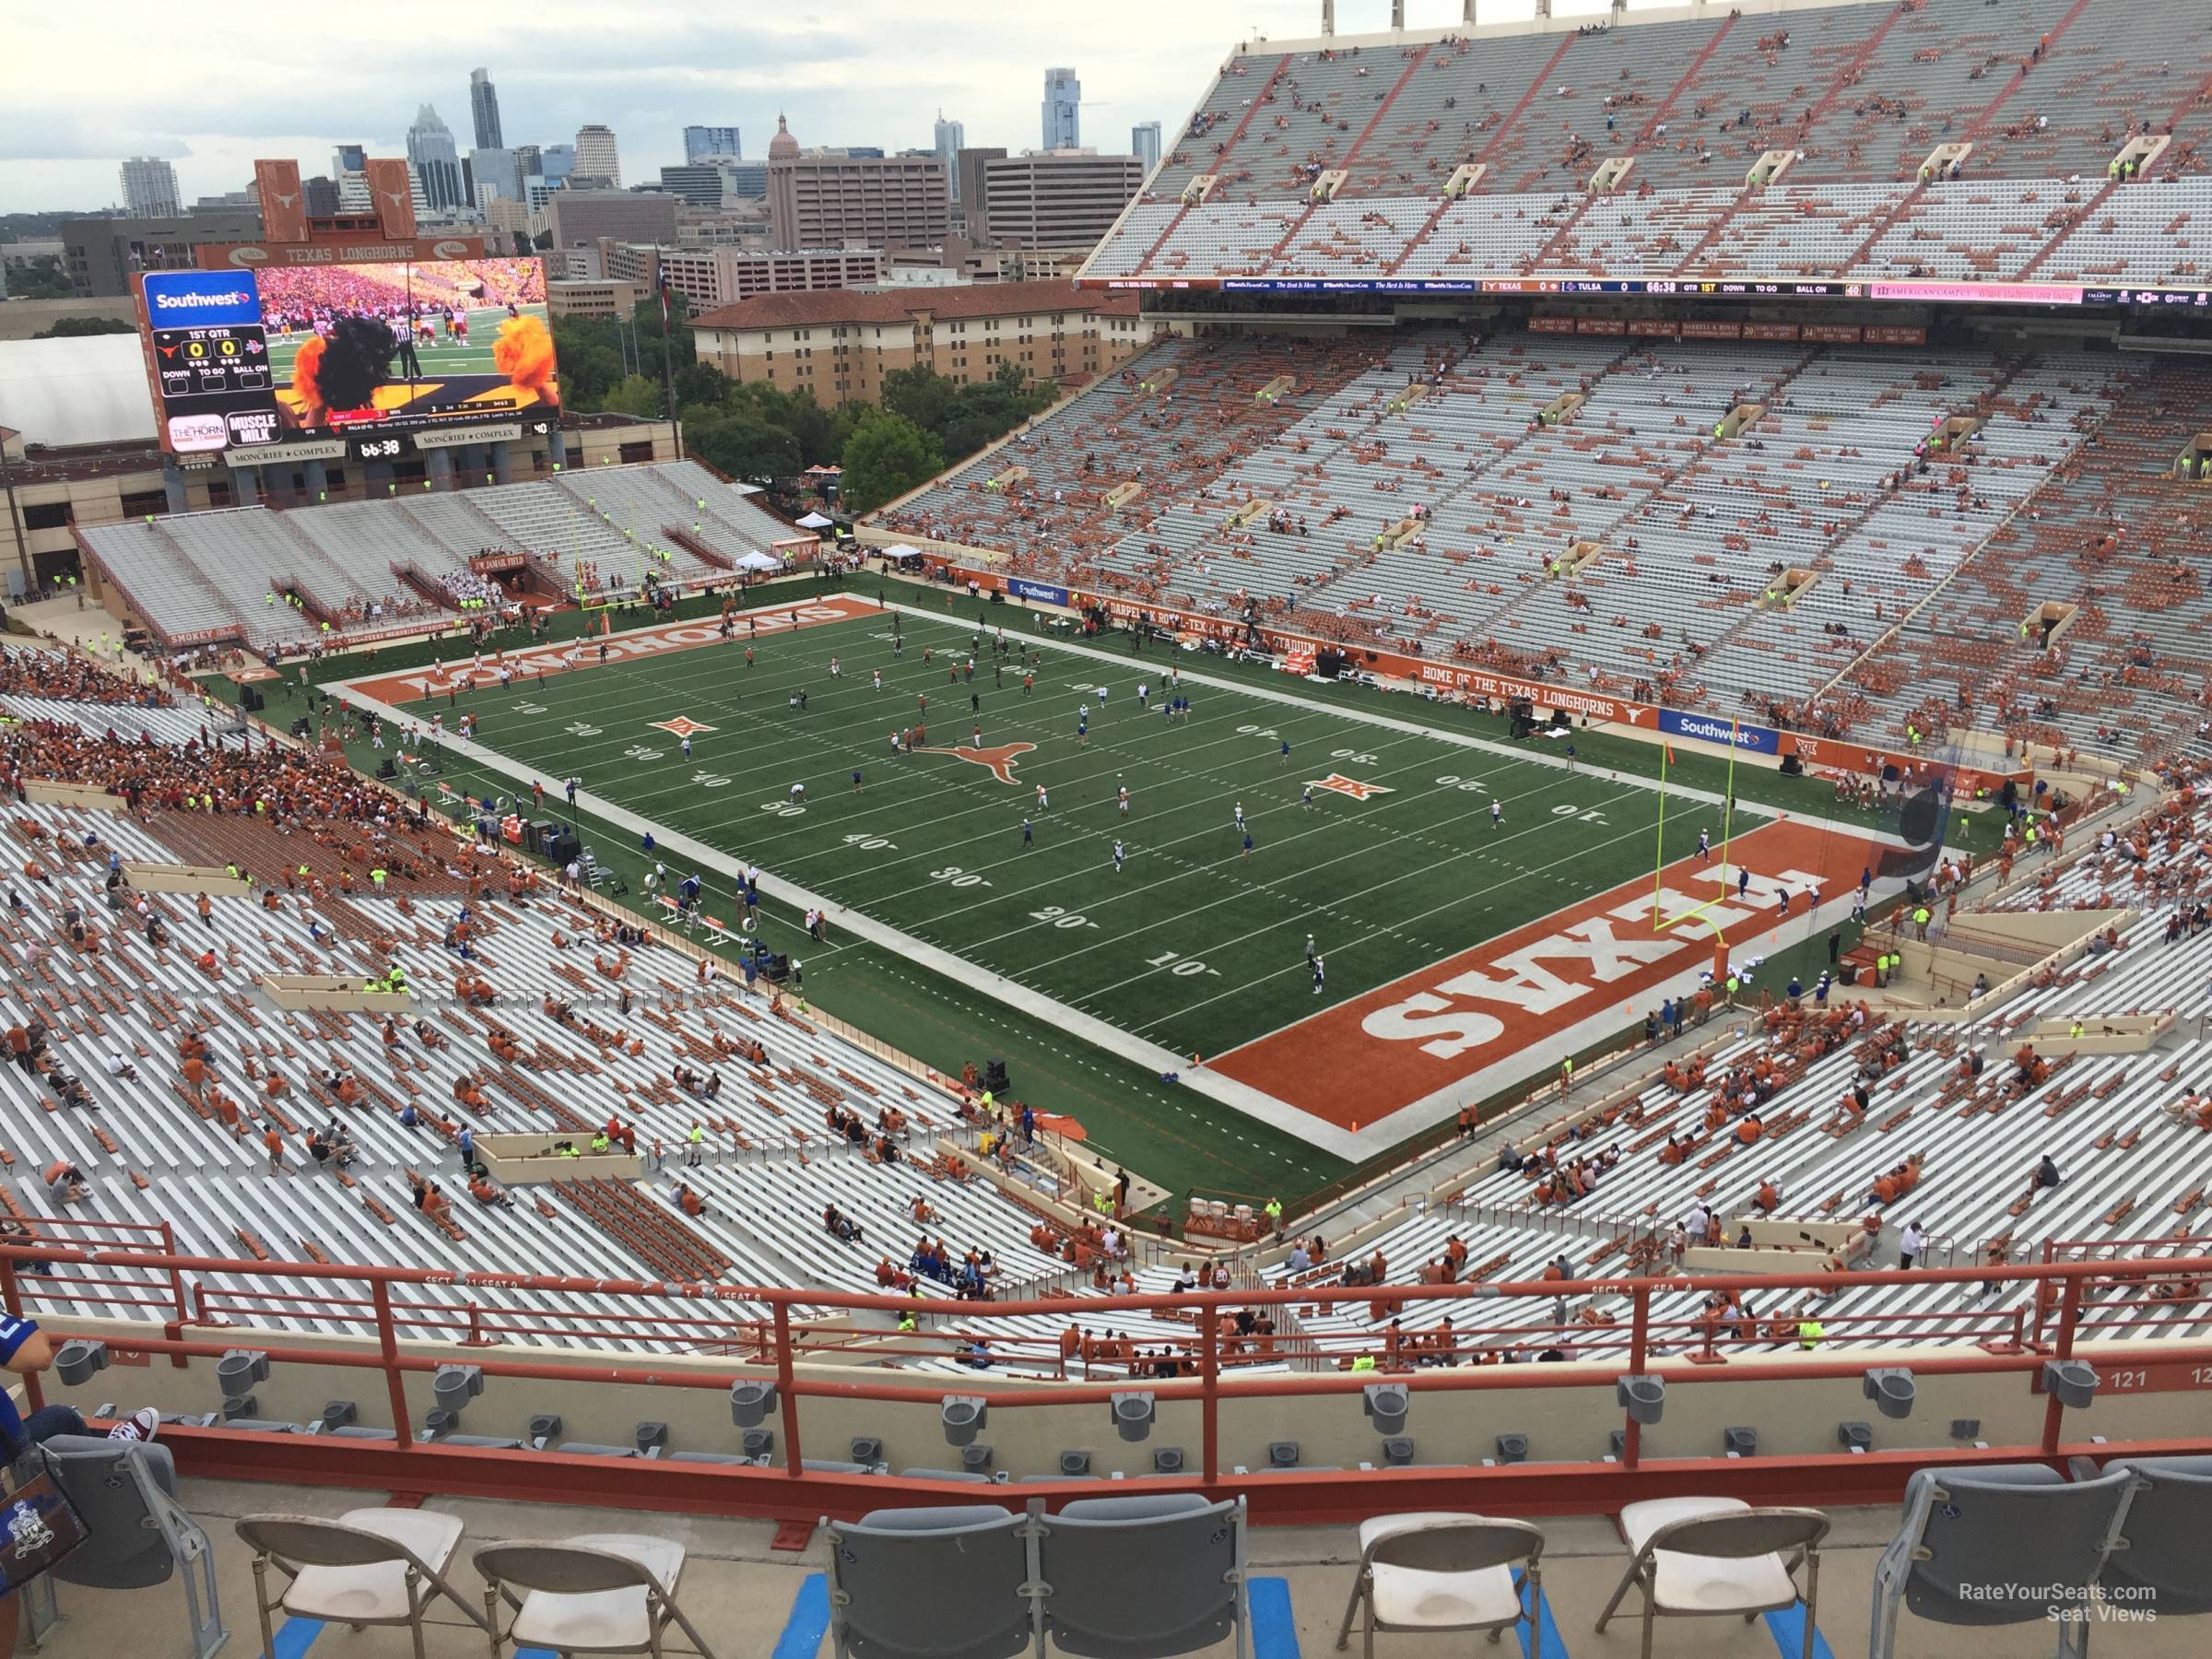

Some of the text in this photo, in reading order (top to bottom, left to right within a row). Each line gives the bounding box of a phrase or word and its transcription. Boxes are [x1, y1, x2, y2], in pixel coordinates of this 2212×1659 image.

[286, 245, 414, 262] TEXAS LONGHORNS
[1539, 282, 1547, 290] 0
[1621, 283, 1628, 291] 0
[1646, 281, 1676, 292] 66:38
[1700, 284, 1716, 292] 1ST
[1846, 286, 1860, 295] 40
[156, 291, 240, 309] Southwest
[188, 329, 231, 340] 1ST QTR
[1803, 328, 1814, 337] 34
[189, 340, 235, 358] 0 0
[162, 370, 191, 379] DOWN
[212, 368, 225, 376] GO
[233, 366, 253, 374] BALL
[229, 414, 276, 430] MUSCLE
[534, 422, 547, 434] 40
[173, 424, 224, 438] THE HORN
[240, 428, 271, 443] MILK
[423, 433, 466, 444] MONCRIEF
[475, 429, 514, 441] COMPLEX
[235, 445, 337, 462] MONCRIEF COMPLEX
[360, 440, 401, 457] 66:38
[508, 556, 524, 567] FIELD
[1018, 584, 1055, 599] Suthwest
[171, 629, 213, 643] SMOKEY
[397, 606, 850, 692] LONGHORNS
[1422, 665, 1614, 716] HOME OF THE TEXAS LONGHORNS
[512, 703, 548, 715] 10
[564, 724, 603, 736] 20
[1680, 718, 1750, 744] Southwest
[624, 747, 665, 761] 30
[690, 772, 733, 787] 40
[760, 799, 807, 818] 50
[841, 832, 890, 850] 40
[929, 866, 982, 887] 30
[1029, 906, 1088, 929] 20
[1145, 950, 1206, 976] 10
[1361, 863, 1830, 1060] TEXAS
[1216, 1272, 1228, 1282] 20
[2110, 1371, 2147, 1388] 121
